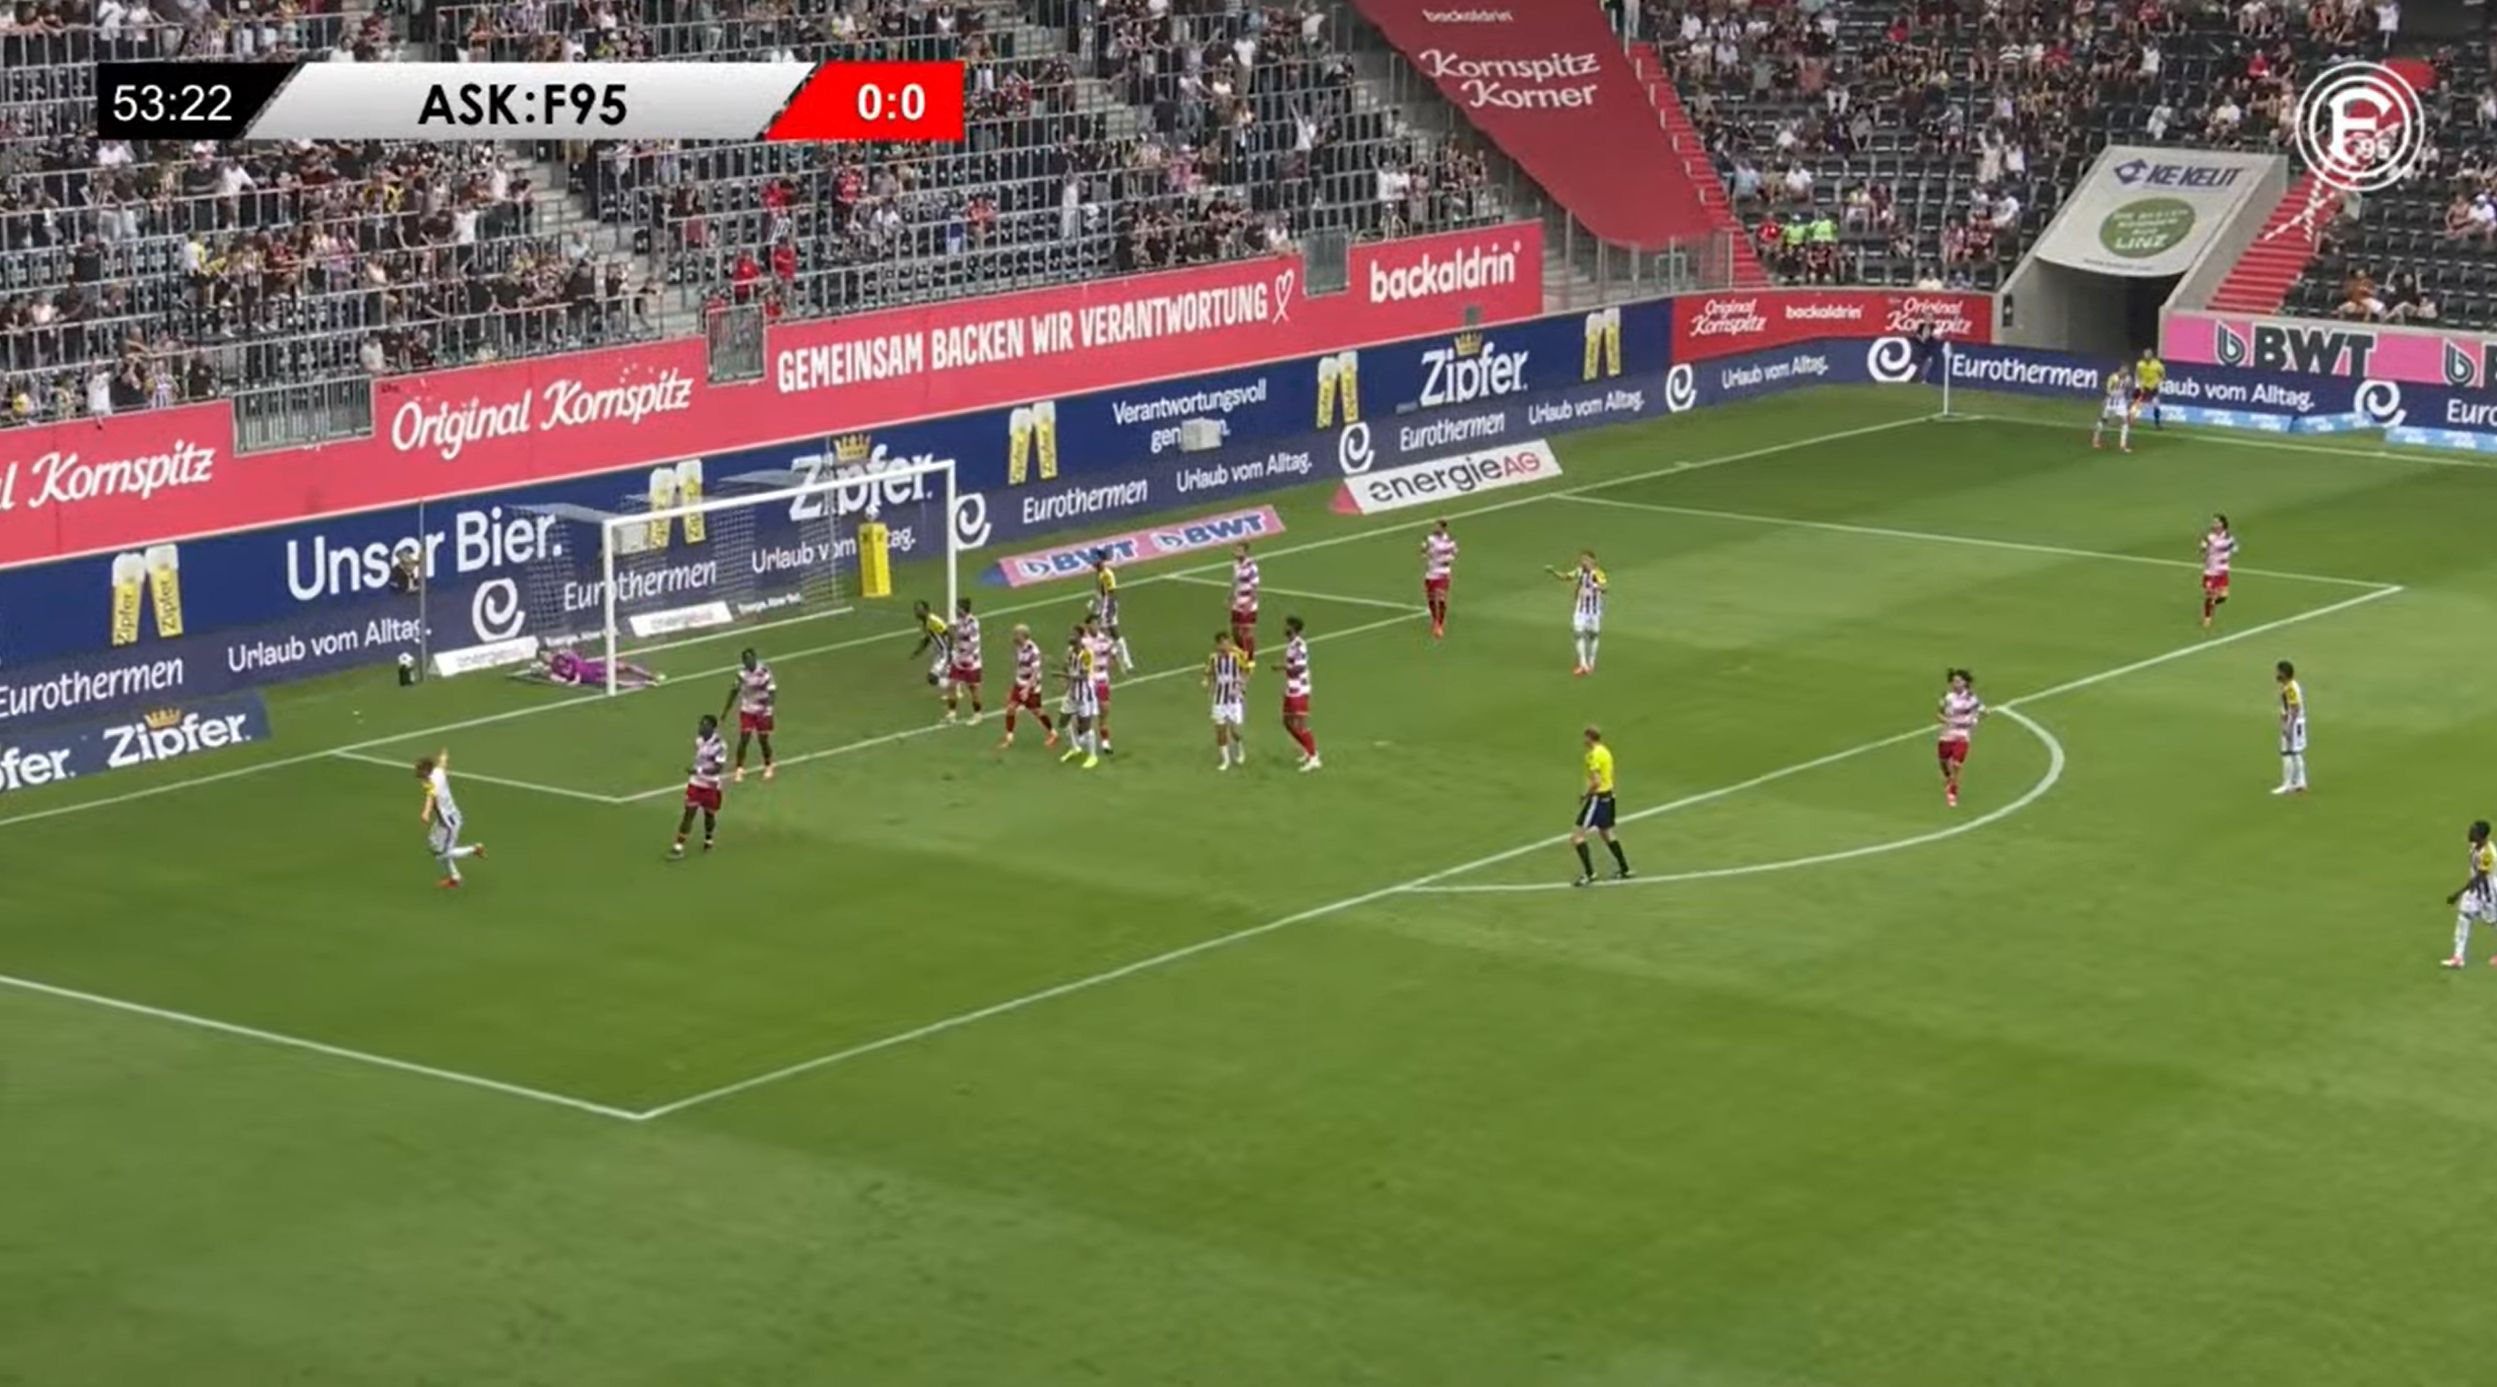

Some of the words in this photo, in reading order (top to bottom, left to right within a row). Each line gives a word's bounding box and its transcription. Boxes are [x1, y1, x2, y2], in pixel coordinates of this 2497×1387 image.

[1419, 49, 1600, 83] Kornspitz
[1461, 79, 1597, 108] Korner
[2147, 164, 2181, 185] KE
[1691, 315, 1767, 336] Kornspitz
[1705, 298, 1757, 317] Original
[777, 332, 924, 393] GEMEINSAM
[932, 313, 1024, 370] BACKEN
[1031, 304, 1074, 353] WIR
[1080, 283, 1268, 346] VERANTWORTUNG
[2252, 324, 2376, 376] BWT
[1722, 364, 1763, 389] Urlaub
[1764, 362, 1790, 380] vom
[1952, 353, 2099, 389] Eurothermen
[391, 389, 532, 460] Original
[540, 369, 694, 430] Kornspitz
[1113, 378, 1267, 426] Verantwortungsvoll
[1527, 400, 1571, 425] Urlaub
[1572, 395, 1602, 418] vom
[1604, 388, 1645, 411] Alltag.
[2205, 385, 2248, 402] vom
[2252, 384, 2314, 411] Alltag.
[1400, 412, 1505, 451] Eurothermen
[28, 439, 215, 508] Kornspitz
[1176, 468, 1227, 493] Urlaub
[1230, 460, 1264, 484] vom
[1266, 451, 1312, 477] Alltag.
[1022, 478, 1148, 524] Eurothermen
[456, 506, 562, 573] Bier.
[1184, 513, 1265, 545] BWT
[752, 541, 813, 573] Urlaub
[228, 642, 305, 673] Urlaub
[311, 627, 358, 656] vom
